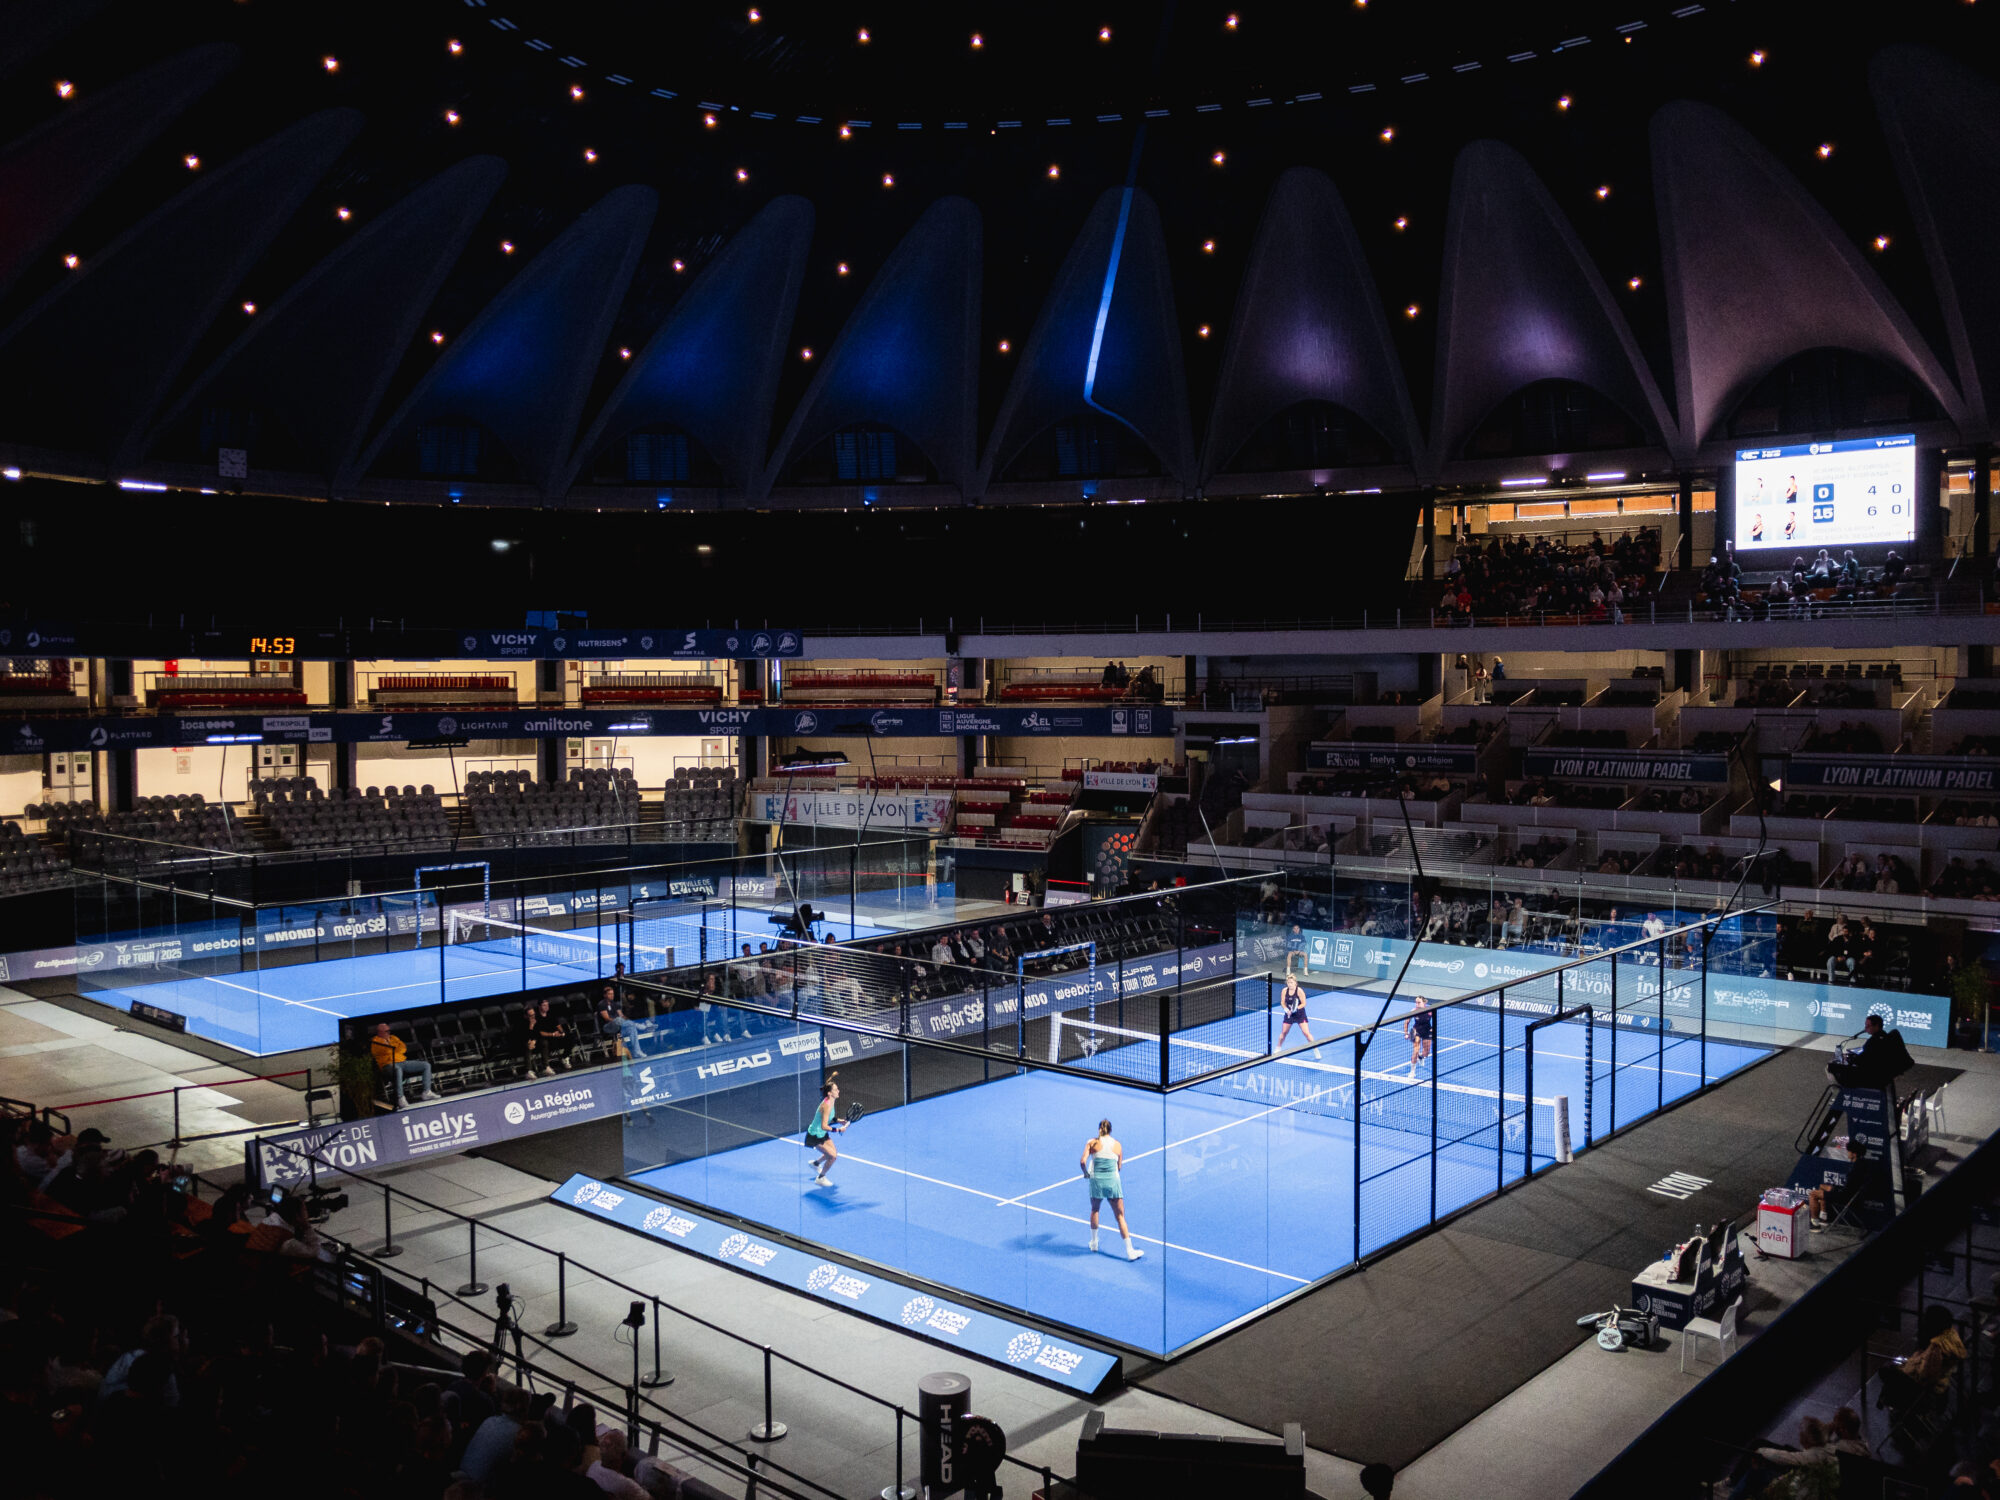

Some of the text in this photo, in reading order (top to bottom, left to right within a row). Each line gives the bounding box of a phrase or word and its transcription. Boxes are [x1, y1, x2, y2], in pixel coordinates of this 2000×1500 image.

[1817, 483, 1902, 499] 0 4 0
[1812, 504, 1902, 520] 15 6 0
[250, 636, 296, 655] 14:53
[490, 634, 538, 646] VICHY
[577, 639, 623, 648] NUTRISENS
[499, 647, 529, 655] SPORT
[523, 716, 594, 732] amiltone
[697, 711, 752, 723] VICHY
[1020, 714, 1051, 728] AXEL
[460, 721, 509, 730] LIGHTAIR
[709, 726, 742, 735] SPORT
[956, 723, 980, 731] RHÔNE
[1338, 758, 1361, 768] LYON
[1369, 753, 1396, 766] inelys
[1426, 756, 1454, 766] Région
[1552, 759, 1693, 780] LYON PLATINUM PADEL
[1099, 777, 1115, 785] VILLE
[1821, 766, 1995, 790] LYON PLATINUM PADEL
[802, 802, 908, 817] VILLE DE LYON
[729, 879, 766, 896] inelys
[581, 896, 591, 904] La
[275, 926, 326, 943] MONDO
[132, 940, 182, 952] CUPRA
[1338, 943, 1351, 952] TEN
[117, 953, 131, 967] FIP
[131, 950, 156, 965] TOUR
[160, 947, 182, 961] 2025
[1336, 955, 1349, 964] NIS
[1490, 963, 1502, 974] La
[1578, 969, 1602, 979] VILLE
[1141, 975, 1158, 989] 2025
[1577, 979, 1613, 996] LYON
[1896, 1009, 1932, 1020] LYON
[1896, 1016, 1932, 1025] PLATINUM
[1895, 1021, 1931, 1030] PADEL
[831, 1045, 849, 1057] LYON
[696, 1052, 772, 1080] HEAD
[525, 1088, 593, 1112] La Région
[630, 1095, 655, 1106] SERFIM
[530, 1101, 596, 1121] Auvergne-Rhône-Alpes
[401, 1111, 477, 1142] inelys
[304, 1124, 373, 1150] VILLE DE
[310, 1139, 378, 1174] LYON
[1645, 1170, 1714, 1200] LYON
[598, 1190, 625, 1202] LYON
[668, 1215, 698, 1228] LYON
[1760, 1229, 1789, 1244] evian
[747, 1242, 778, 1256] LYON
[839, 1274, 871, 1289] LYON
[935, 1307, 972, 1323] LYON
[1042, 1344, 1084, 1363] LYON
[939, 1403, 953, 1485] HEAD
